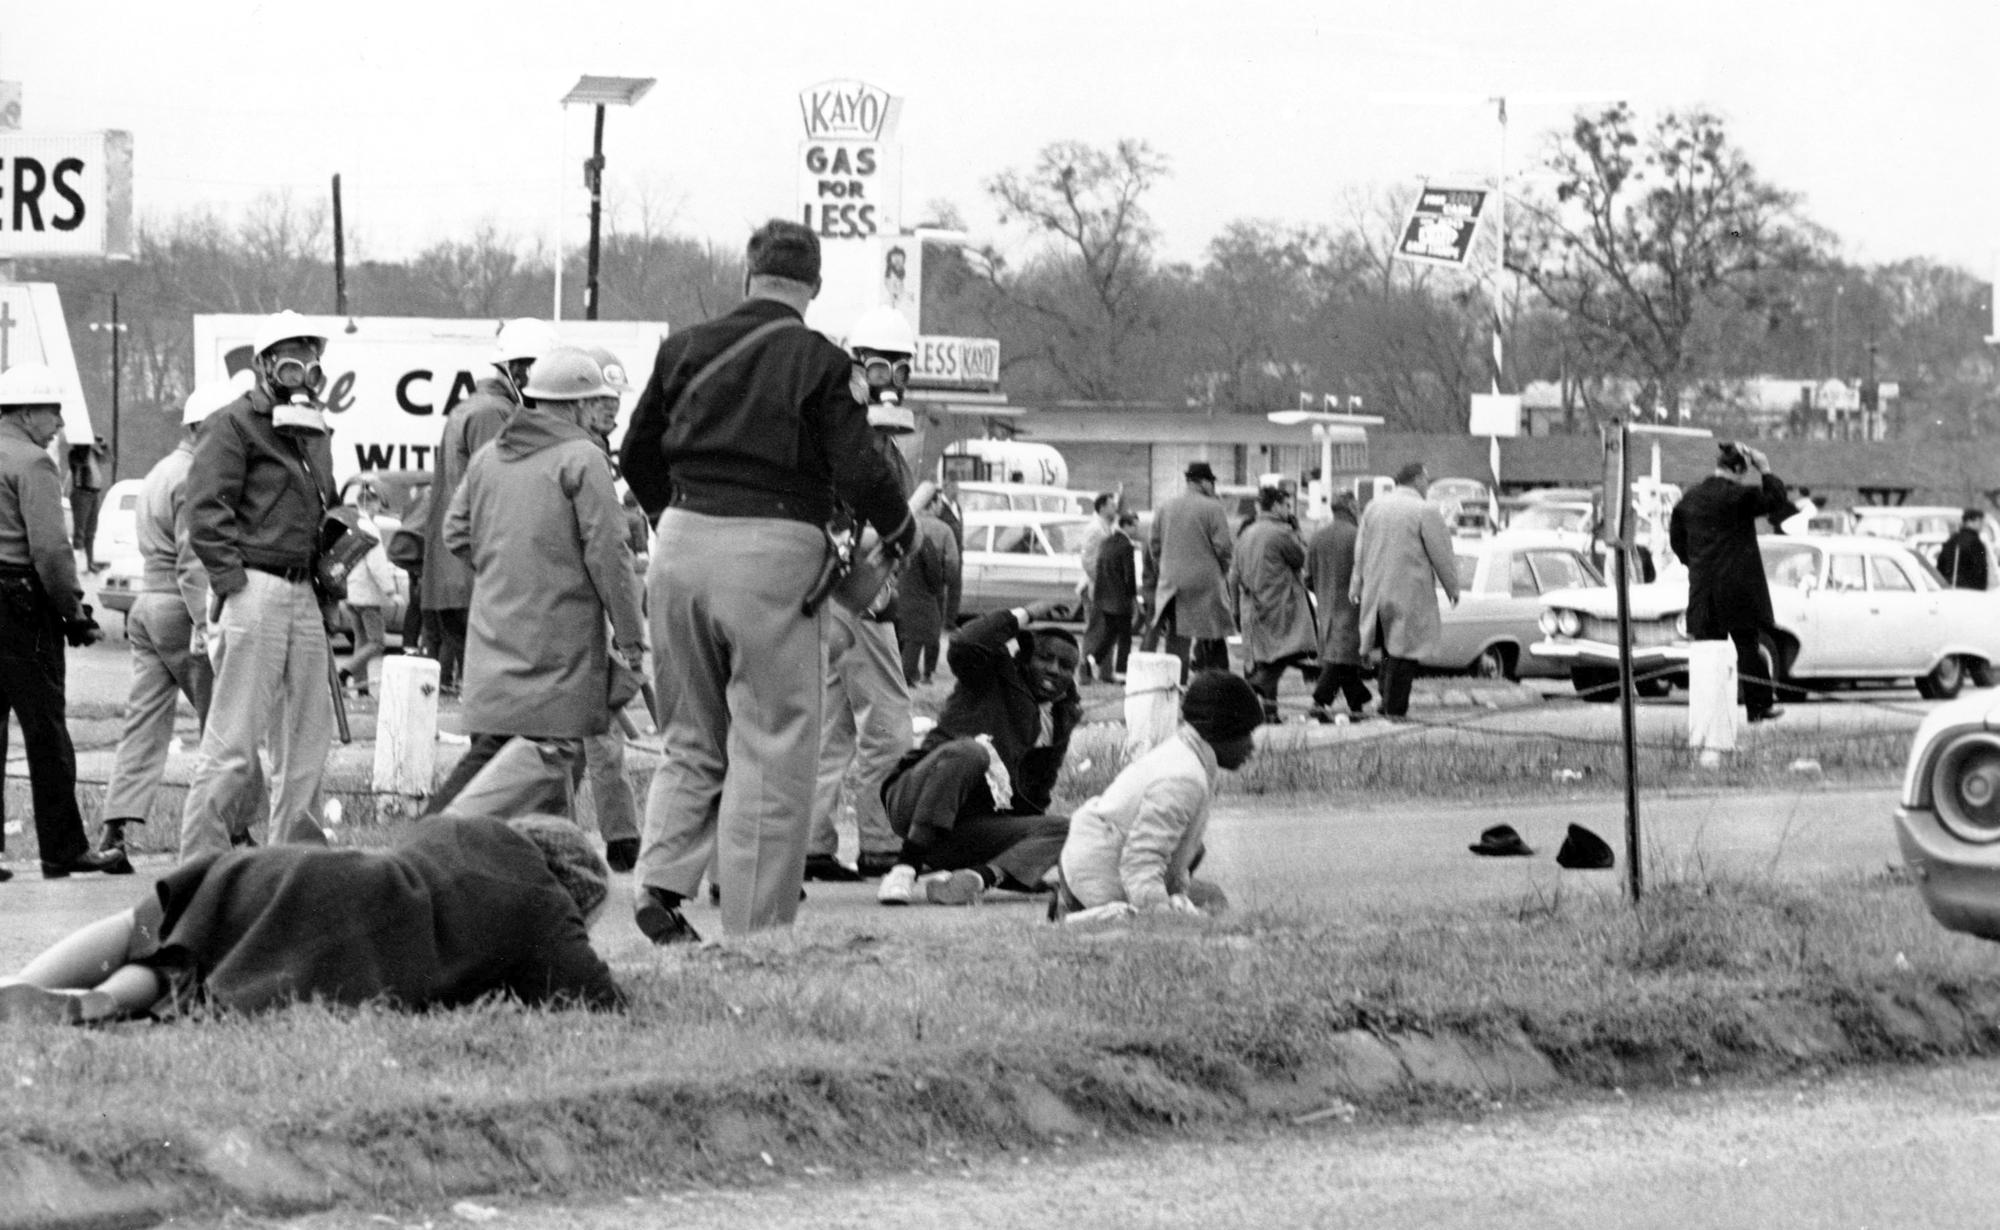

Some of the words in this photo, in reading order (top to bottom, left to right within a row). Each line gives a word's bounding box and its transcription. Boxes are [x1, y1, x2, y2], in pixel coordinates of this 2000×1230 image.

[812, 88, 878, 133] KAYO
[806, 146, 876, 175] GAS
[0, 156, 86, 231] RS
[818, 180, 865, 198] FOR
[804, 203, 876, 239] LESS
[914, 342, 956, 374] LESS
[395, 369, 477, 416] CA
[355, 444, 439, 472] WIT
